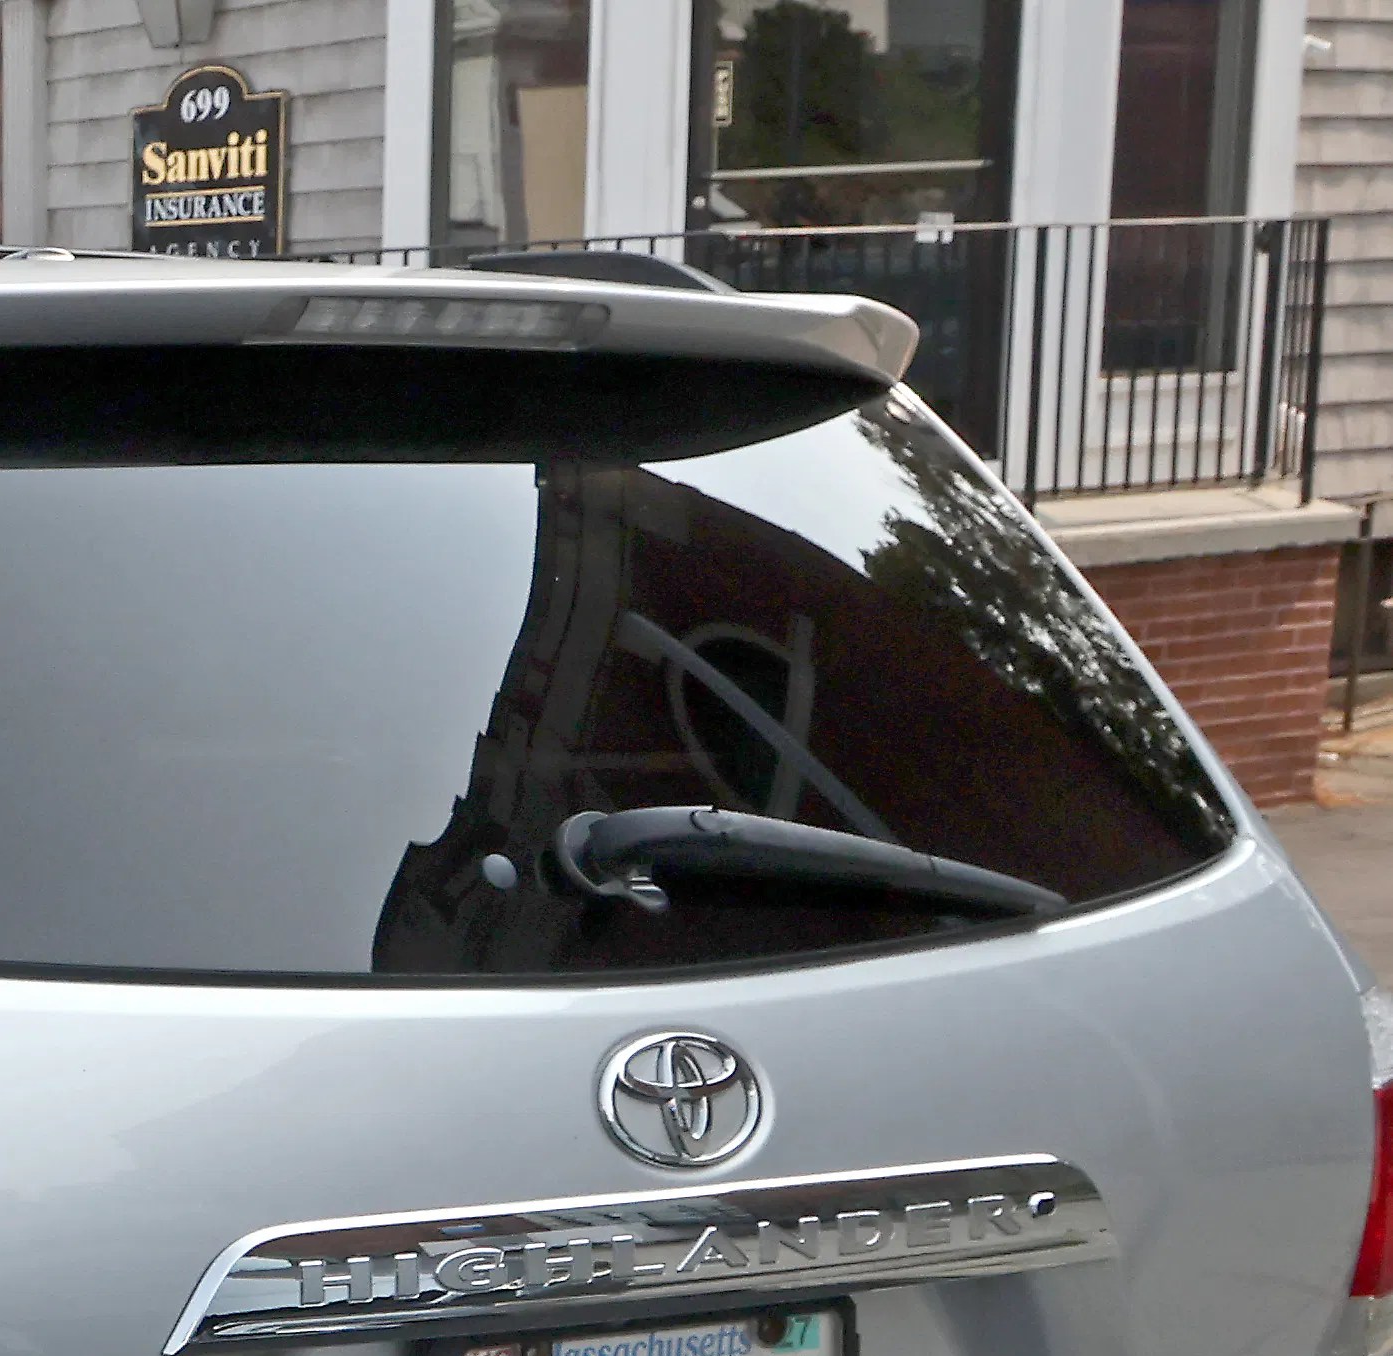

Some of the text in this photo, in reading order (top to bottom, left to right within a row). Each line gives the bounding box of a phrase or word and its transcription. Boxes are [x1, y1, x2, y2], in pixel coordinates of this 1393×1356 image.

[180, 86, 230, 124] 699
[141, 129, 269, 186] Sanviti
[145, 191, 266, 222] INSURANCE
[298, 1194, 1020, 1306] HIGHLANDER
[782, 1317, 810, 1349] 7
